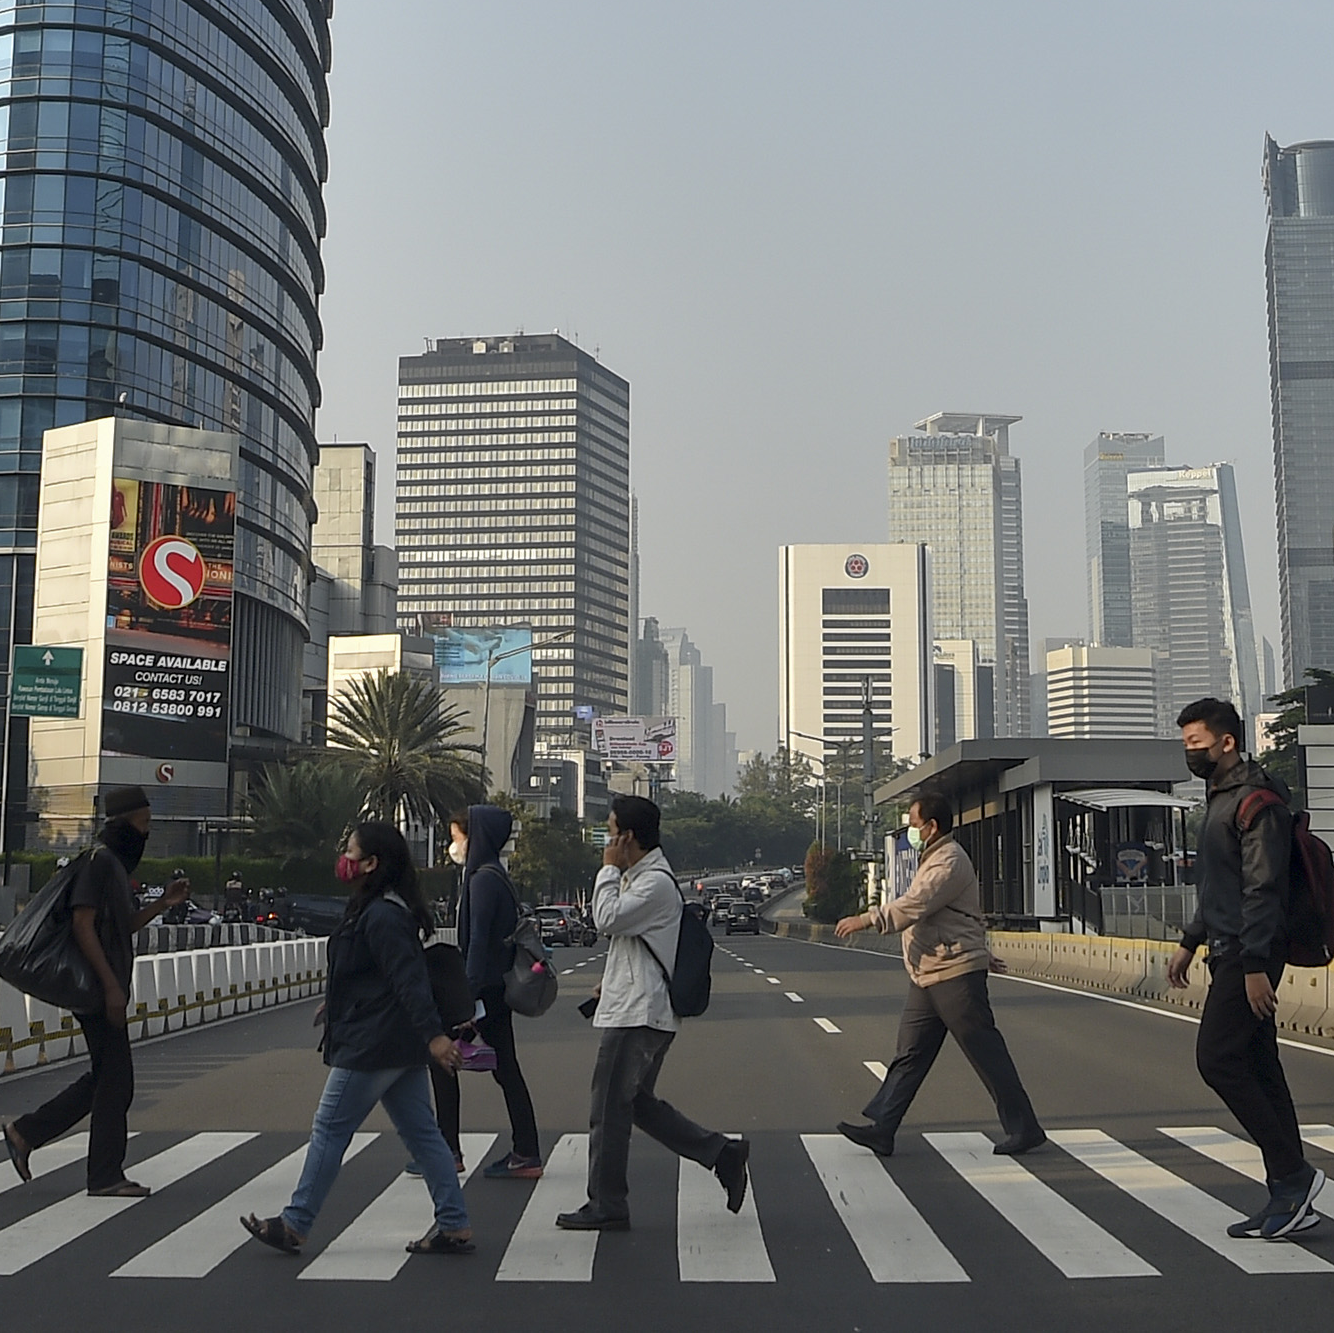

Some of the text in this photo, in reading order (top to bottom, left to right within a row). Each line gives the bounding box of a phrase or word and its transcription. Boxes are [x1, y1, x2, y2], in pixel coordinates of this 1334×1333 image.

[1178, 469, 1212, 481] Keppel
[109, 652, 228, 672] SPACE AVAILABLE
[135, 671, 203, 686] CONTACT US!
[114, 686, 139, 697] 021
[152, 688, 185, 702] 6583
[189, 690, 221, 703] 7017
[113, 700, 222, 718] 0812 53800 991
